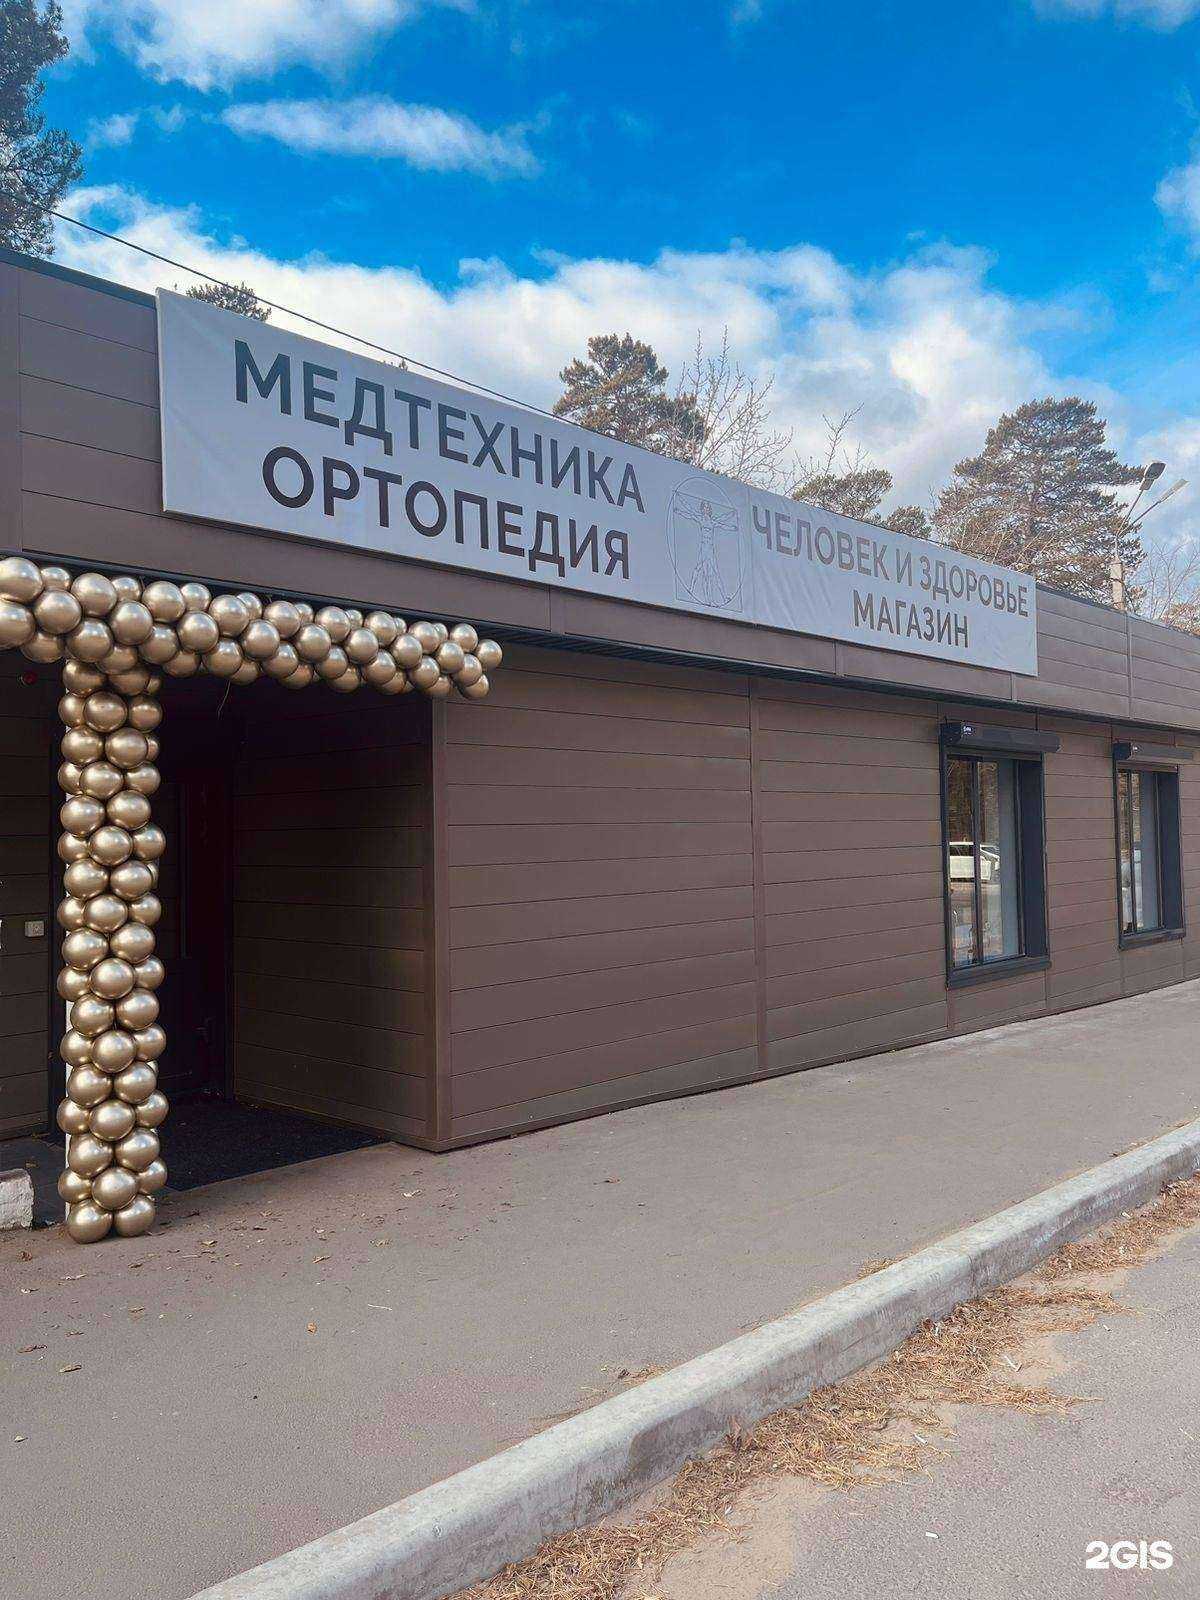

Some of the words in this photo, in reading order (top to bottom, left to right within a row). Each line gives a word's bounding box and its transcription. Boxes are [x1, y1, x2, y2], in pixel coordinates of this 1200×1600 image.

[234, 339, 646, 514] МЕДТЕХНИКА
[262, 446, 630, 580] ОРТОПЕДИЯ
[752, 504, 891, 582] ЧЕЛОВЕК
[895, 547, 913, 588] И
[919, 555, 1029, 618] ЗДОРОВЬЕ
[852, 588, 969, 649] МАГАЗИН
